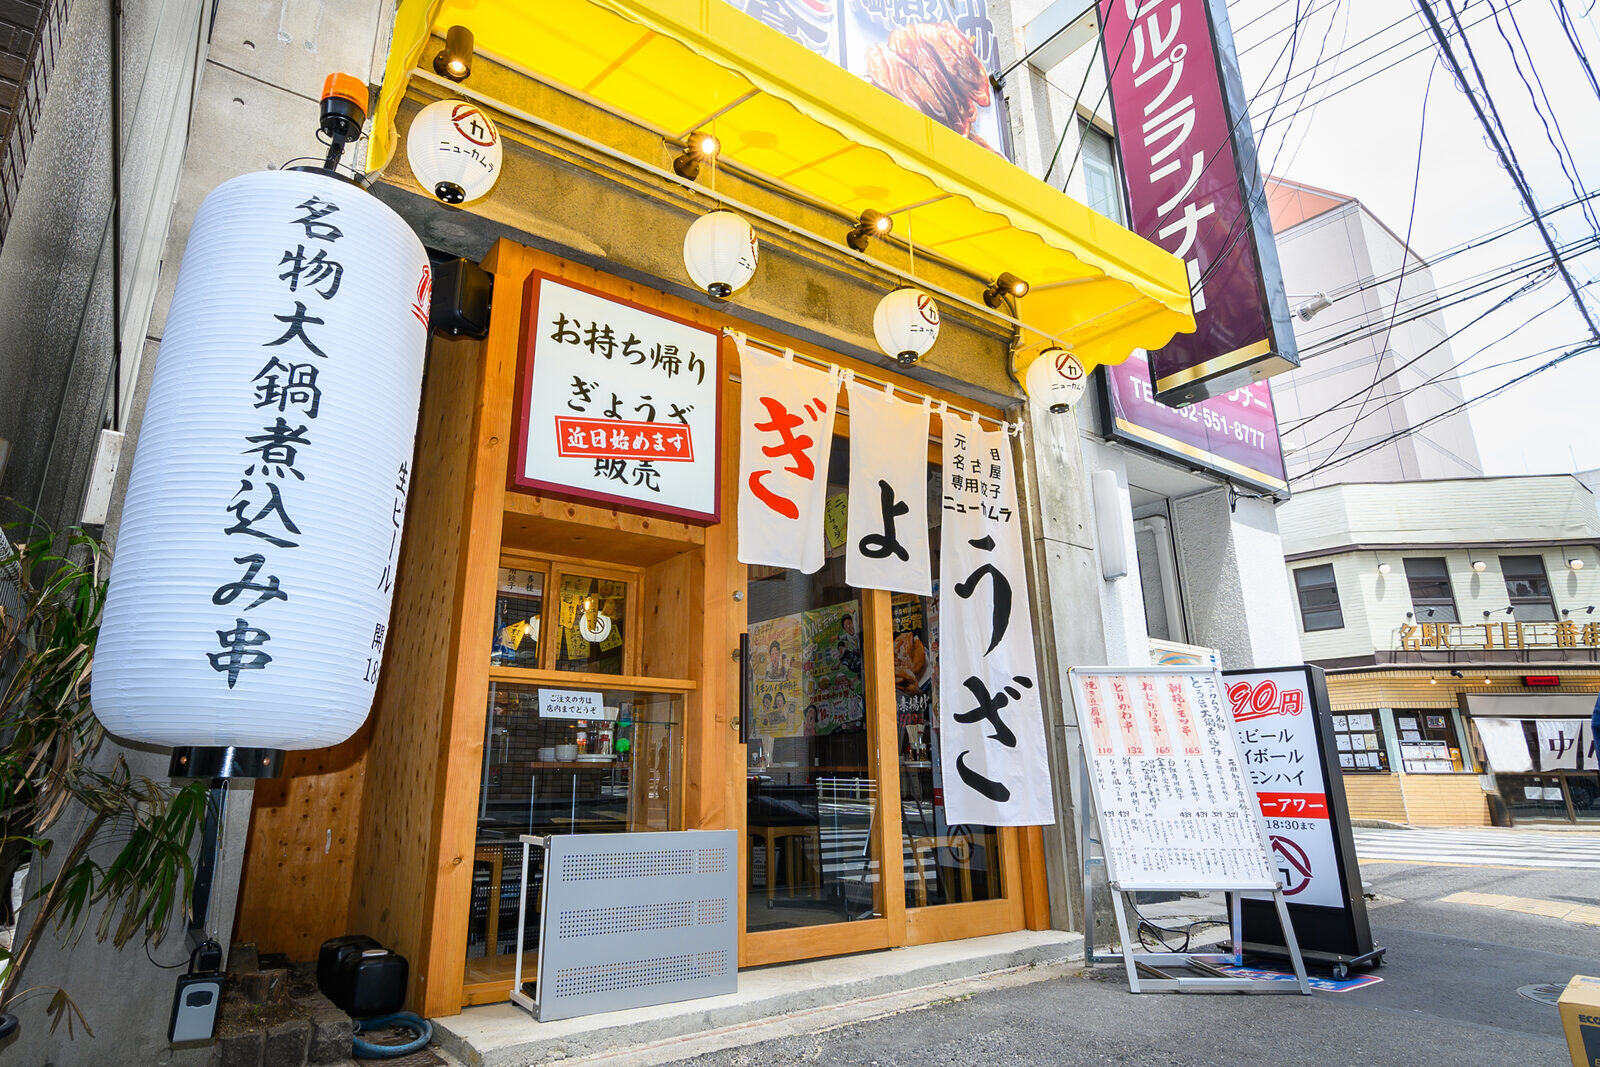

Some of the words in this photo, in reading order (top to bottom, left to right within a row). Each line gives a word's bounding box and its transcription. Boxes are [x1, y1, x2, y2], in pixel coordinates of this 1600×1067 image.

[440, 141, 494, 173] ニューカムラ
[550, 312, 705, 386] お持ち帰り
[1130, 375, 1166, 409] TE
[205, 195, 344, 689] 名物大鍋煮込み串
[567, 427, 684, 452] 近日始めます
[593, 458, 661, 492] 販売
[377, 460, 408, 594] 生ビール
[546, 704, 597, 715] 店内までどうぞ
[550, 694, 592, 704] ご注文の方は
[1112, 681, 1136, 733] とりかわ串
[1224, 680, 1304, 717] 90円
[1126, 746, 1143, 754] 132
[1238, 728, 1294, 746] ビール
[1257, 797, 1324, 813] ーアワー
[1266, 819, 1316, 831] 18:30まで
